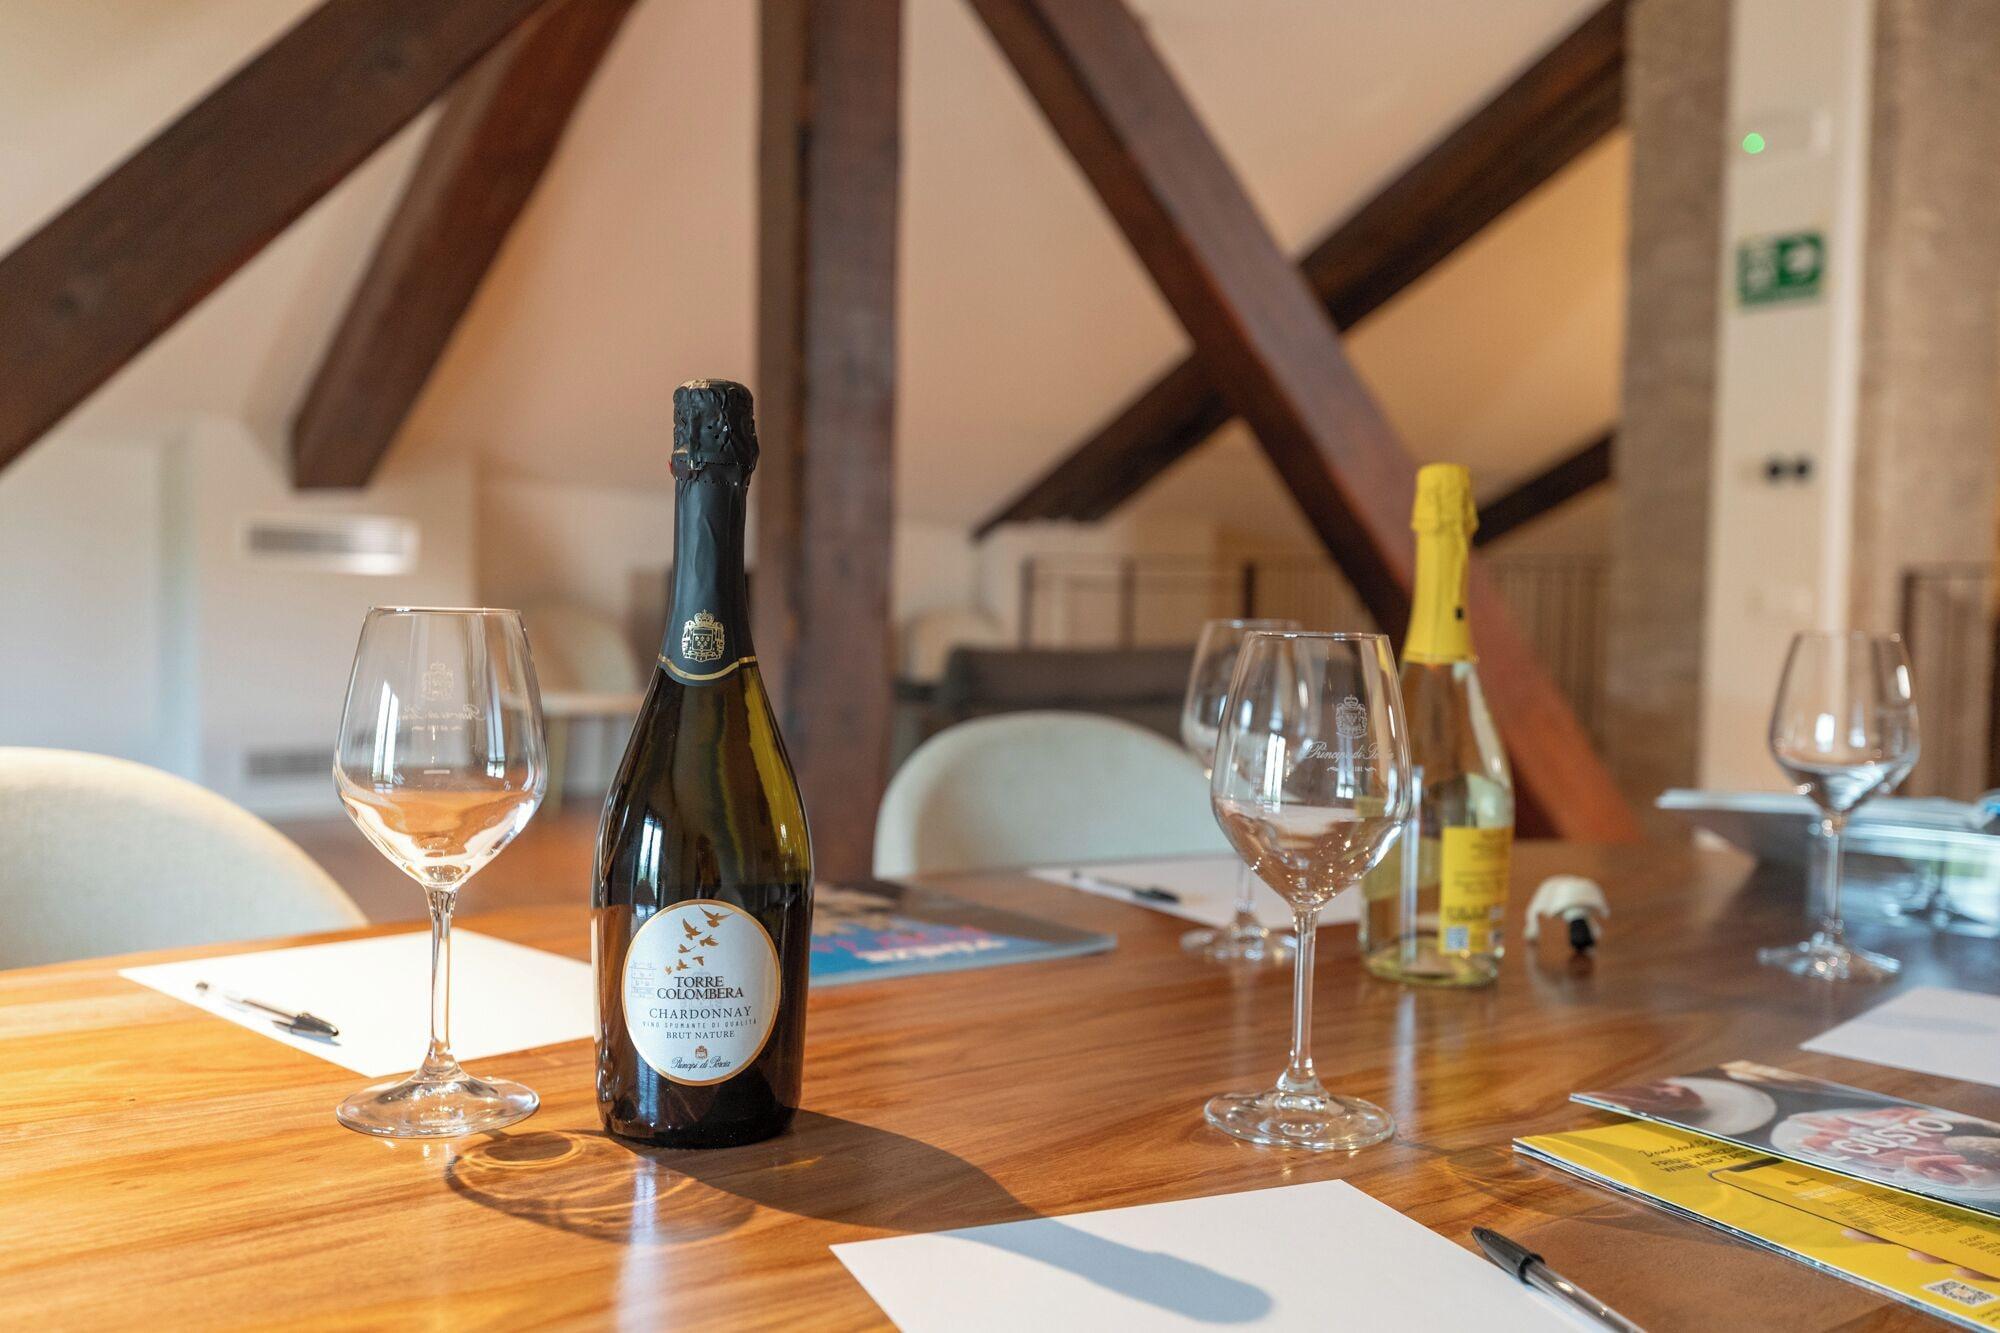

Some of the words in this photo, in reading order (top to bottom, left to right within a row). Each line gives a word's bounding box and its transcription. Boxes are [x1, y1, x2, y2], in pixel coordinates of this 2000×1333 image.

[674, 976, 724, 988] TORRE
[657, 987, 744, 1000] COLOMBERA
[649, 1006, 752, 1019] CHARDONNAY
[666, 1031, 691, 1039] BRUT
[695, 1030, 735, 1039] NATURE
[1832, 1117, 1954, 1155] GUSTO
